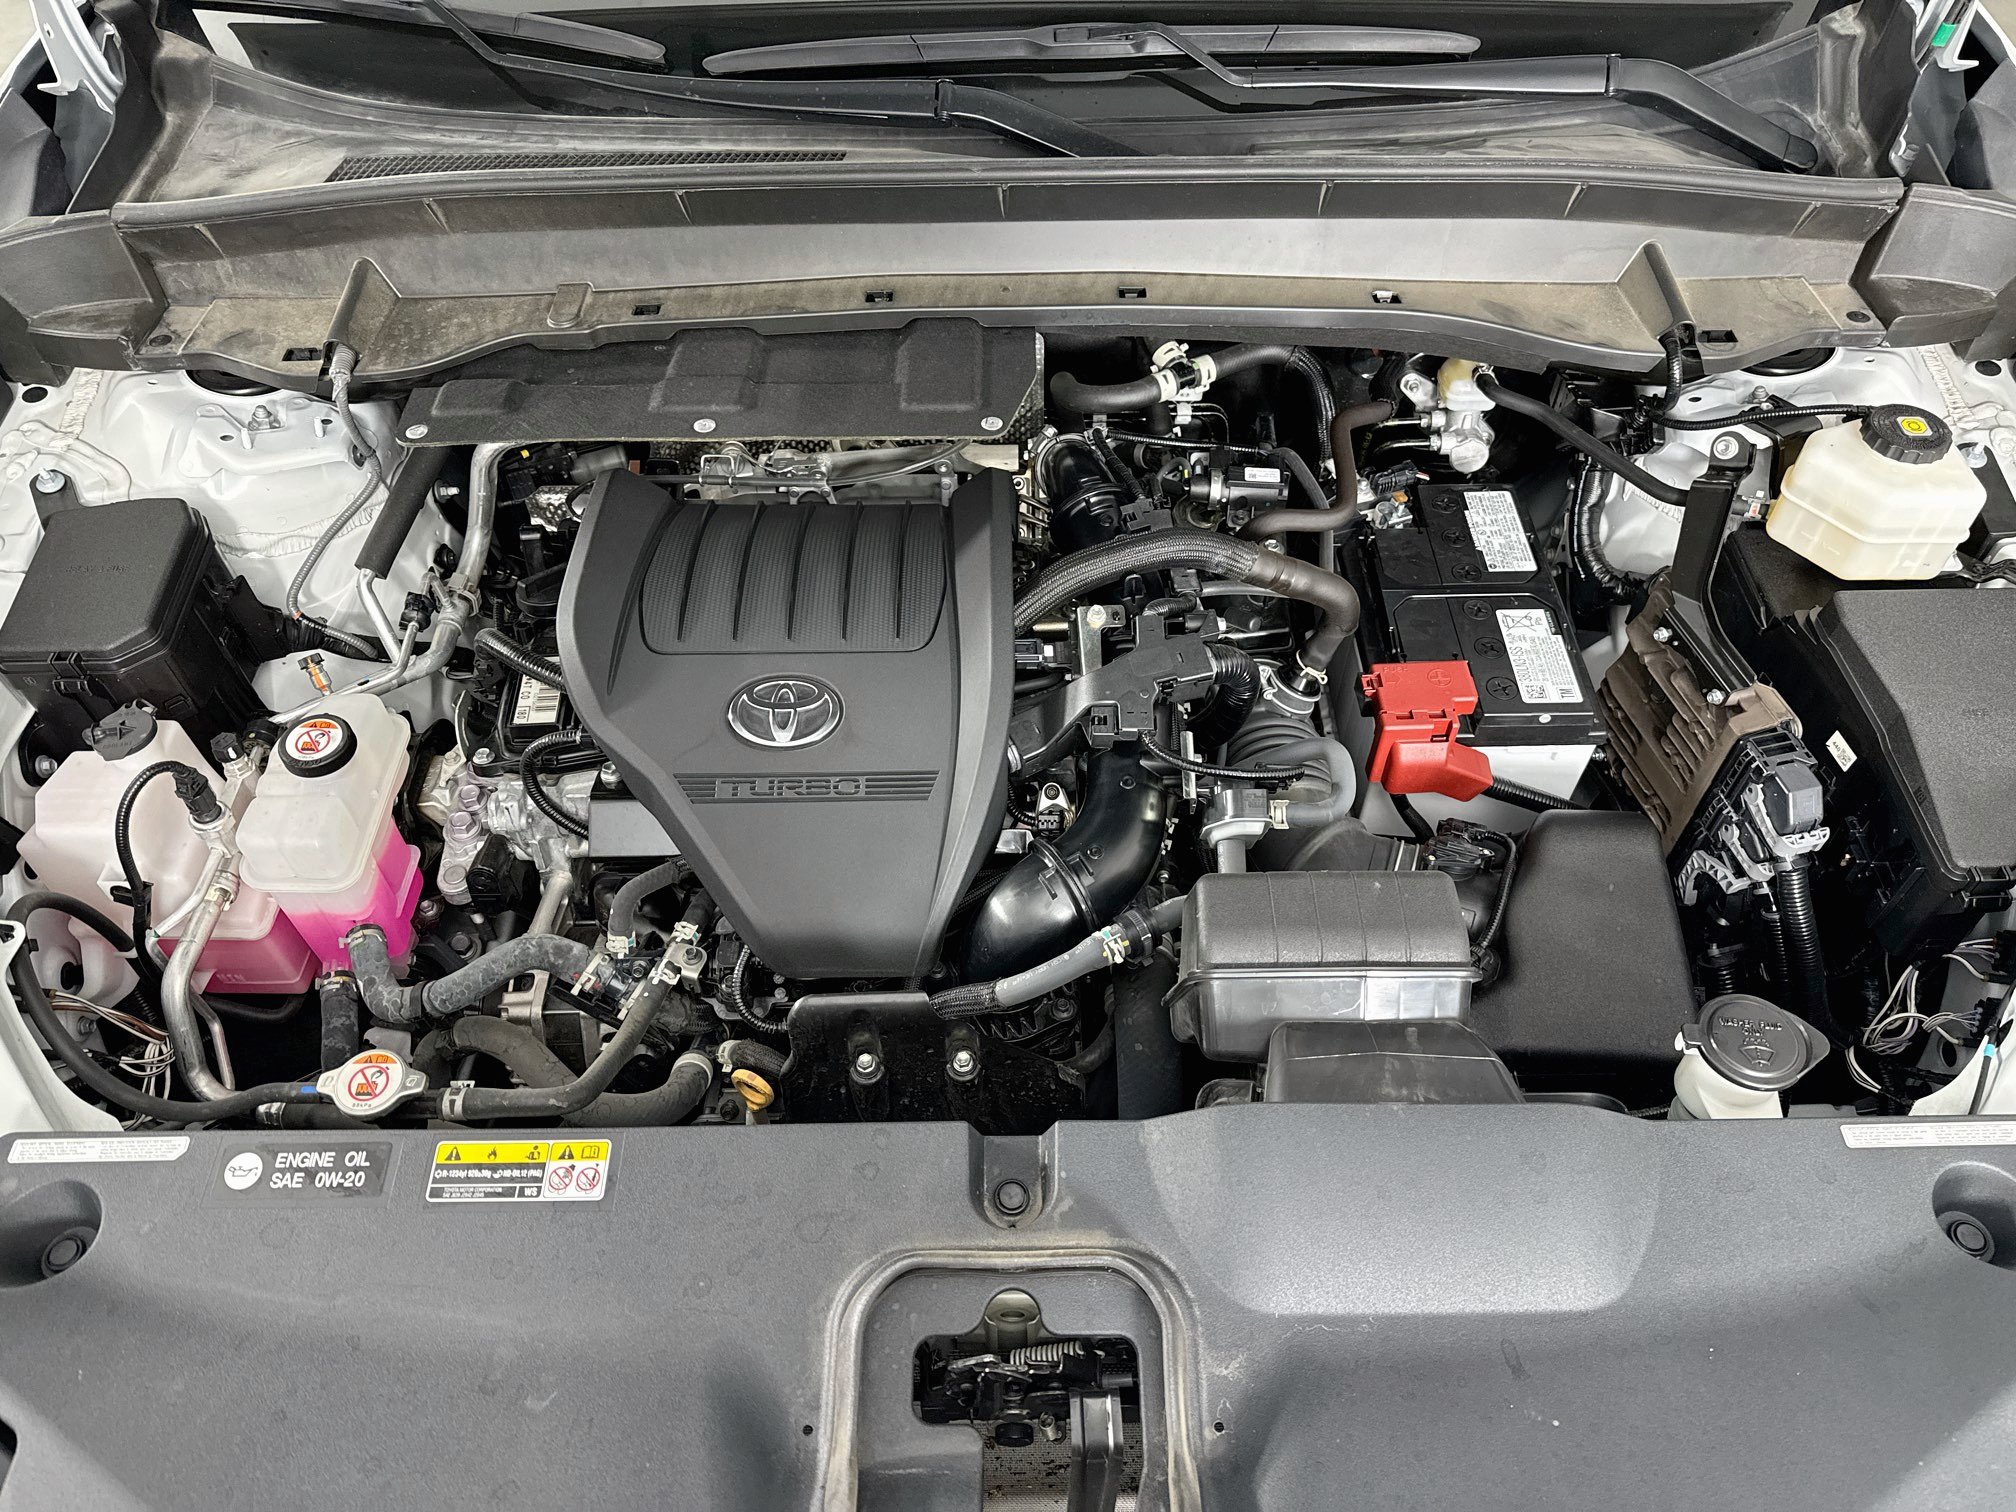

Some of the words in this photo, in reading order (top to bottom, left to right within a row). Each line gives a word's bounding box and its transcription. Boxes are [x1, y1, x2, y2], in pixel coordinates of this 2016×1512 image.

[1559, 688, 1575, 699] TM
[719, 776, 863, 797] TURBO
[1719, 1017, 1755, 1028] WASHER
[1759, 1021, 1783, 1031] FLUID
[1742, 1027, 1764, 1037] ONLY
[275, 1151, 336, 1168] ENGINE
[344, 1150, 371, 1167] OIL
[269, 1172, 305, 1189] SAE
[314, 1171, 366, 1188] 0W-20
[524, 1187, 538, 1197] WS
